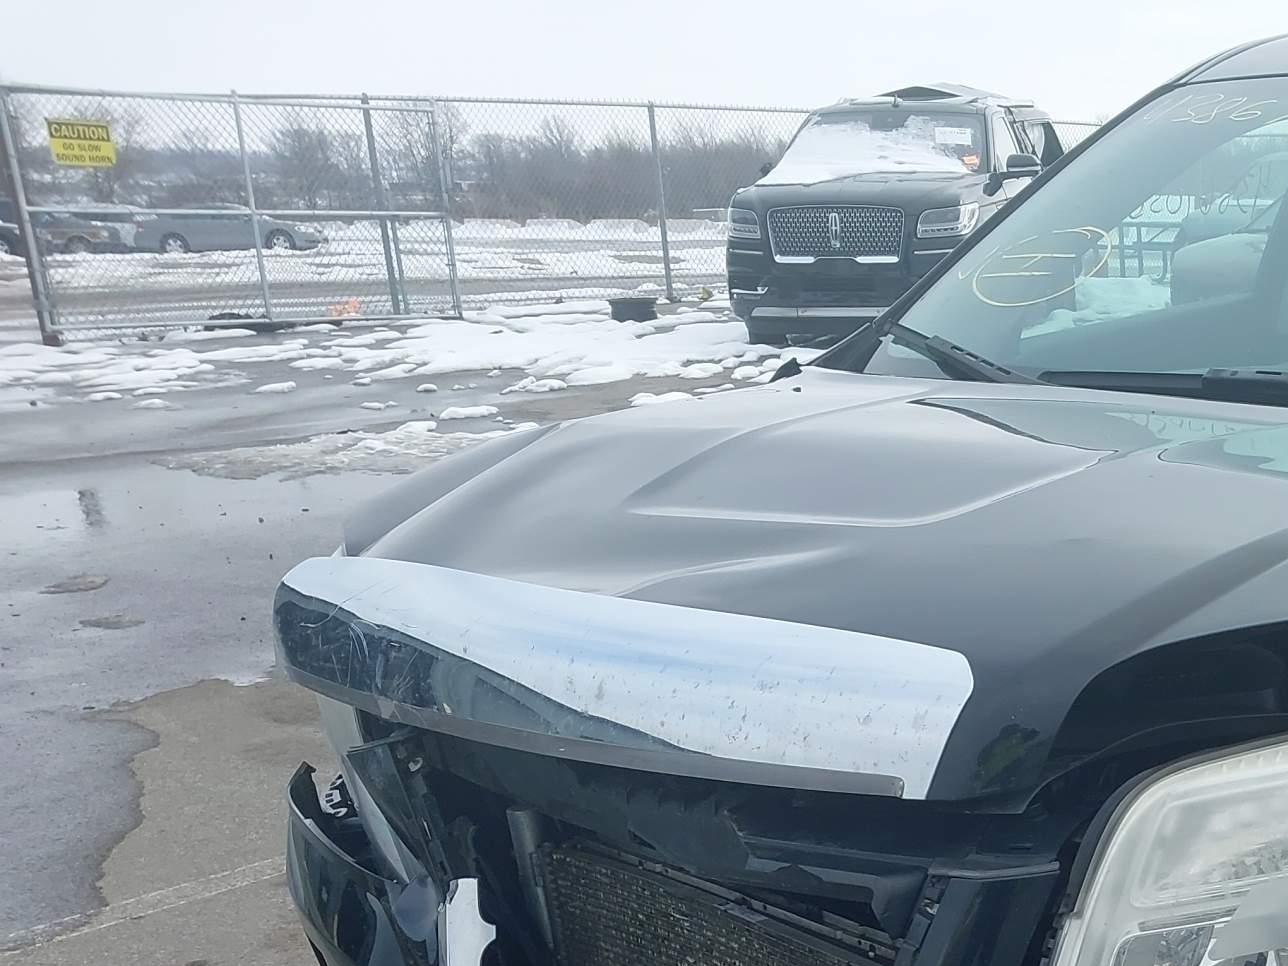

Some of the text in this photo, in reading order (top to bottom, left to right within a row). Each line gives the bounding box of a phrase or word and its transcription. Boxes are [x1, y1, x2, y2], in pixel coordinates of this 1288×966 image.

[51, 123, 108, 141] CAUTION
[63, 142, 102, 153] GO SLOW
[55, 153, 113, 163] SOUND HORN
